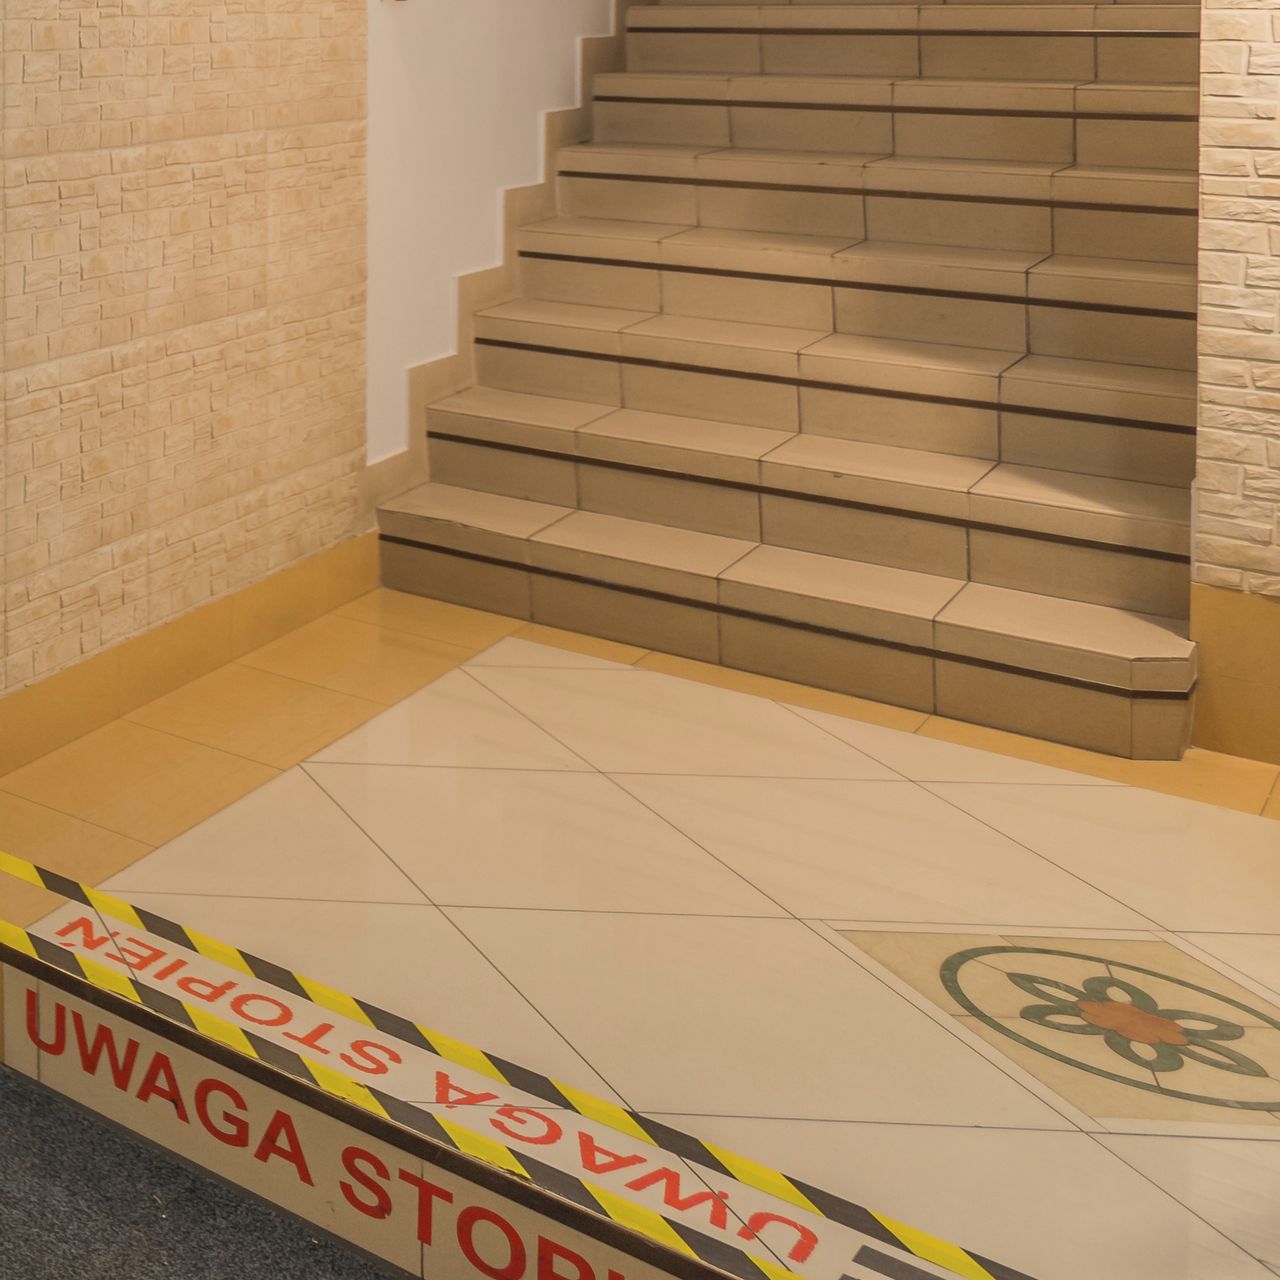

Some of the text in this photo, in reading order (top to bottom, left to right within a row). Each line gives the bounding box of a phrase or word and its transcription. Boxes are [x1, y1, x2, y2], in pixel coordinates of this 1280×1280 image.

[25, 987, 626, 1280] UWAGA STOP
[54, 916, 819, 1264] UWAGA STOPIEŃ
